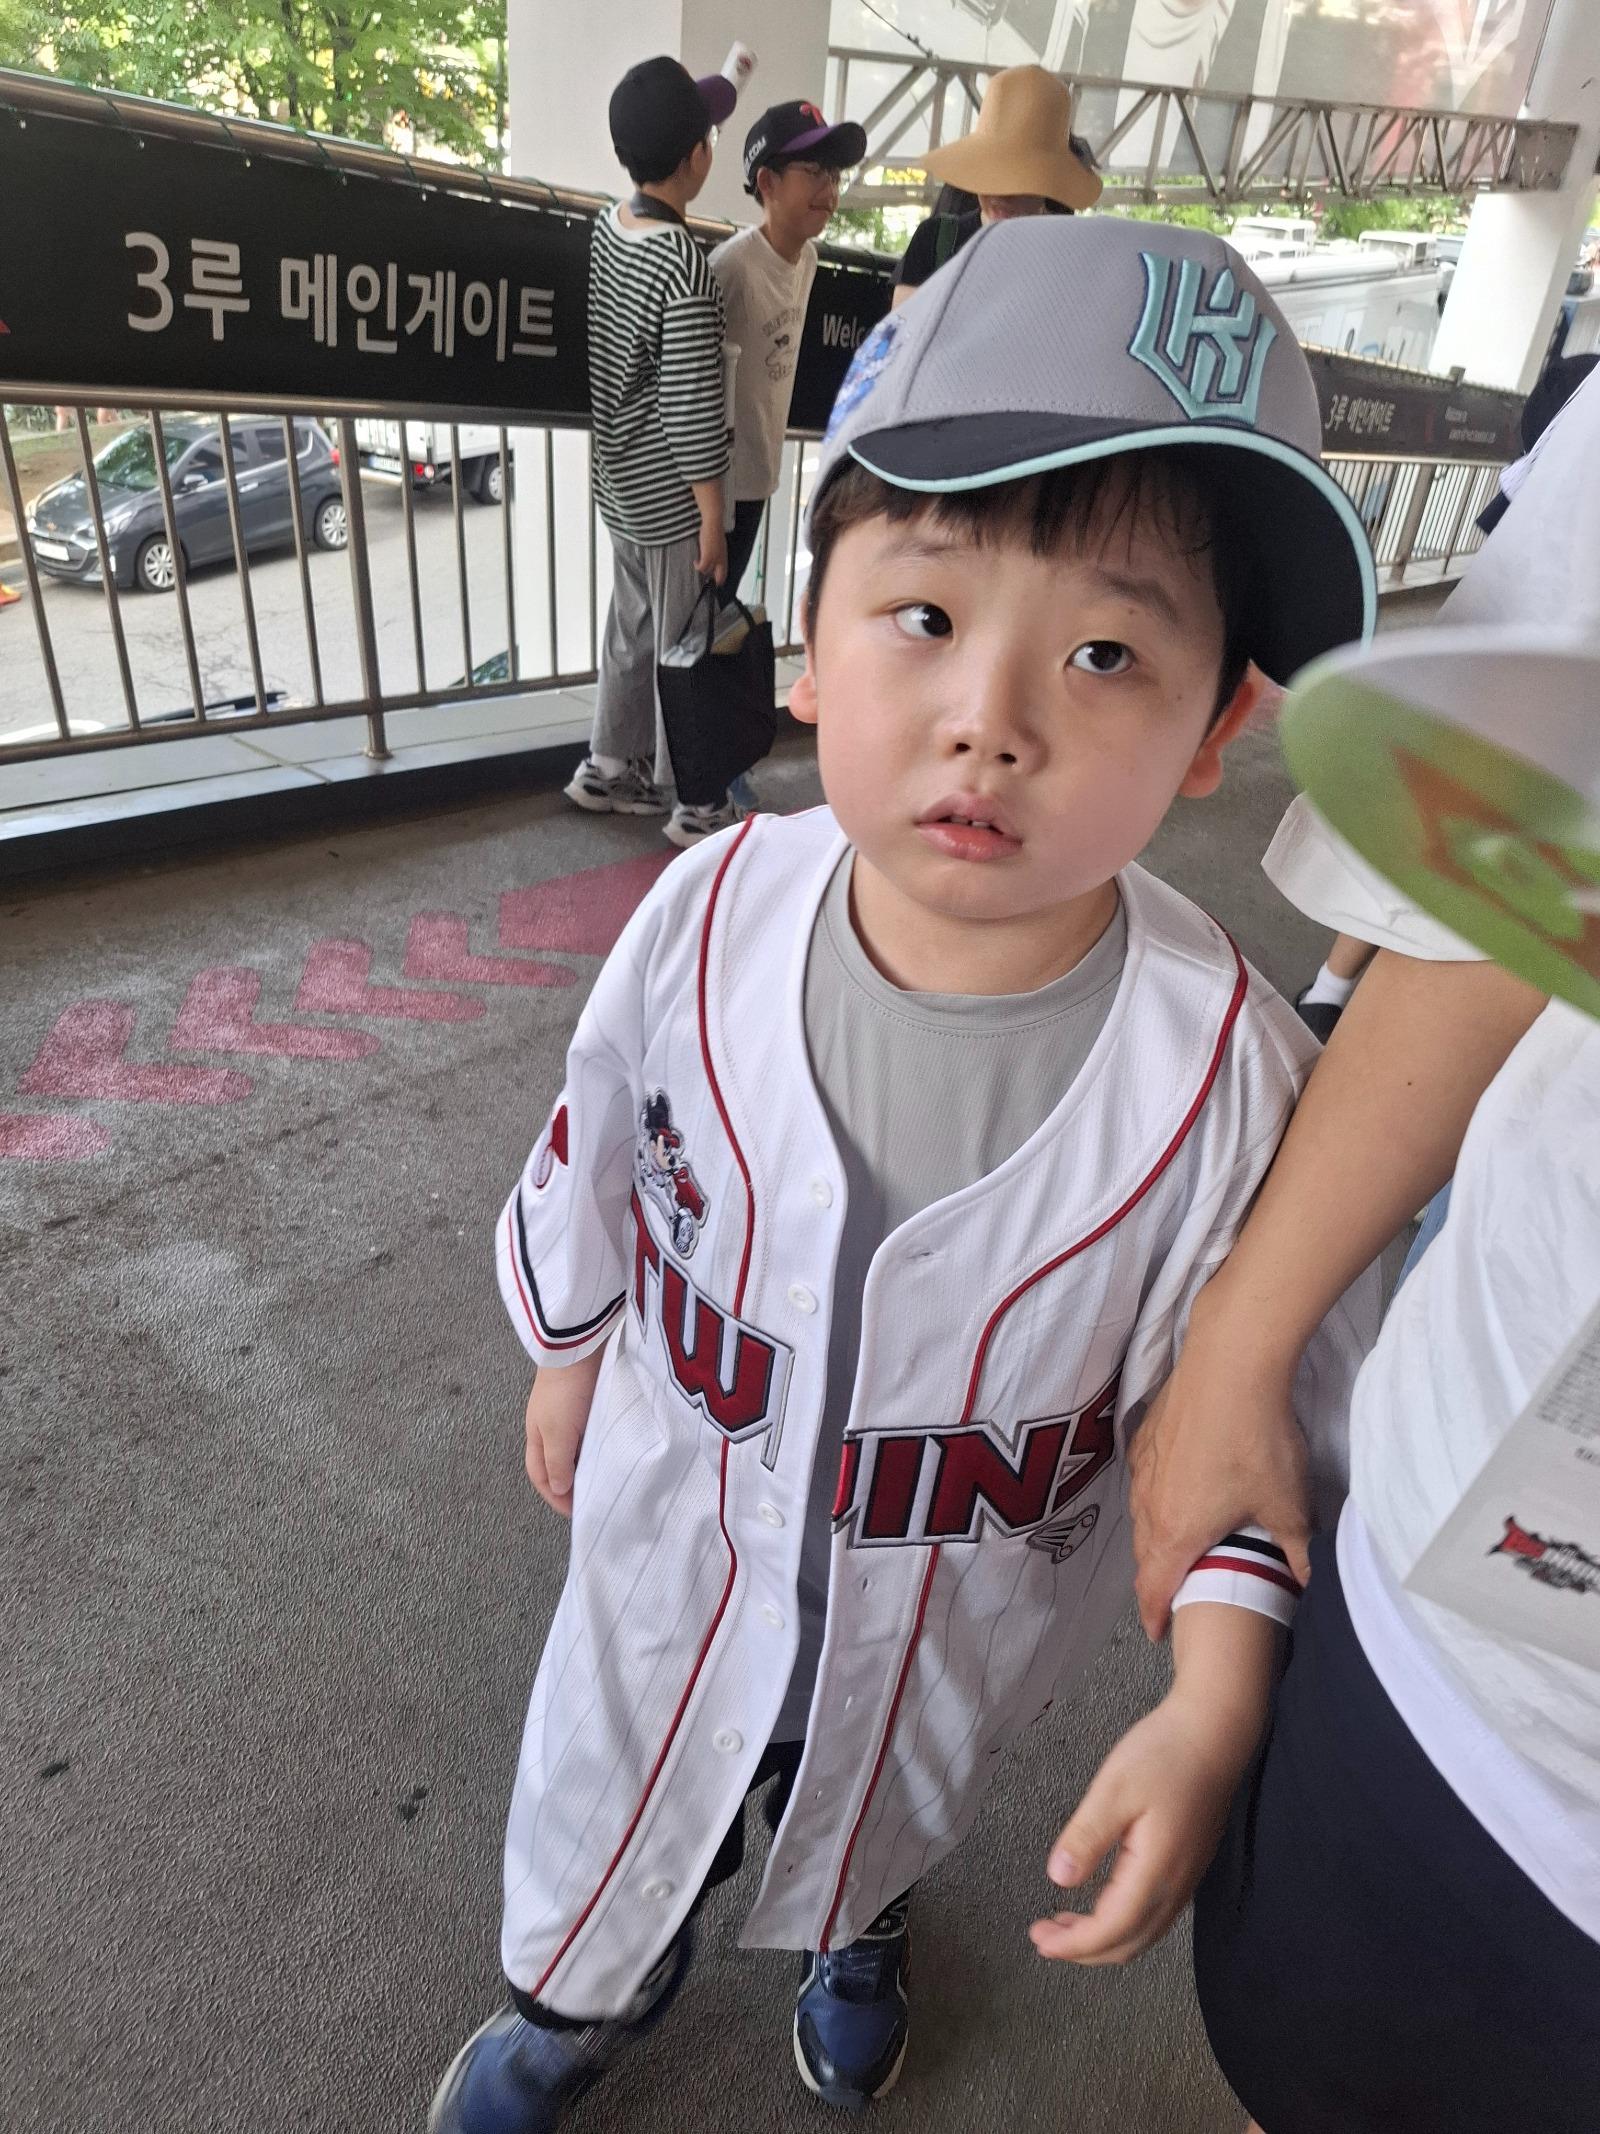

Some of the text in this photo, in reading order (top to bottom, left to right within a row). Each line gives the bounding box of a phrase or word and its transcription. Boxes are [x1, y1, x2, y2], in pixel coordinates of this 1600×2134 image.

[125, 231, 558, 362] 3루 메인게이트
[822, 312, 866, 350] Welc
